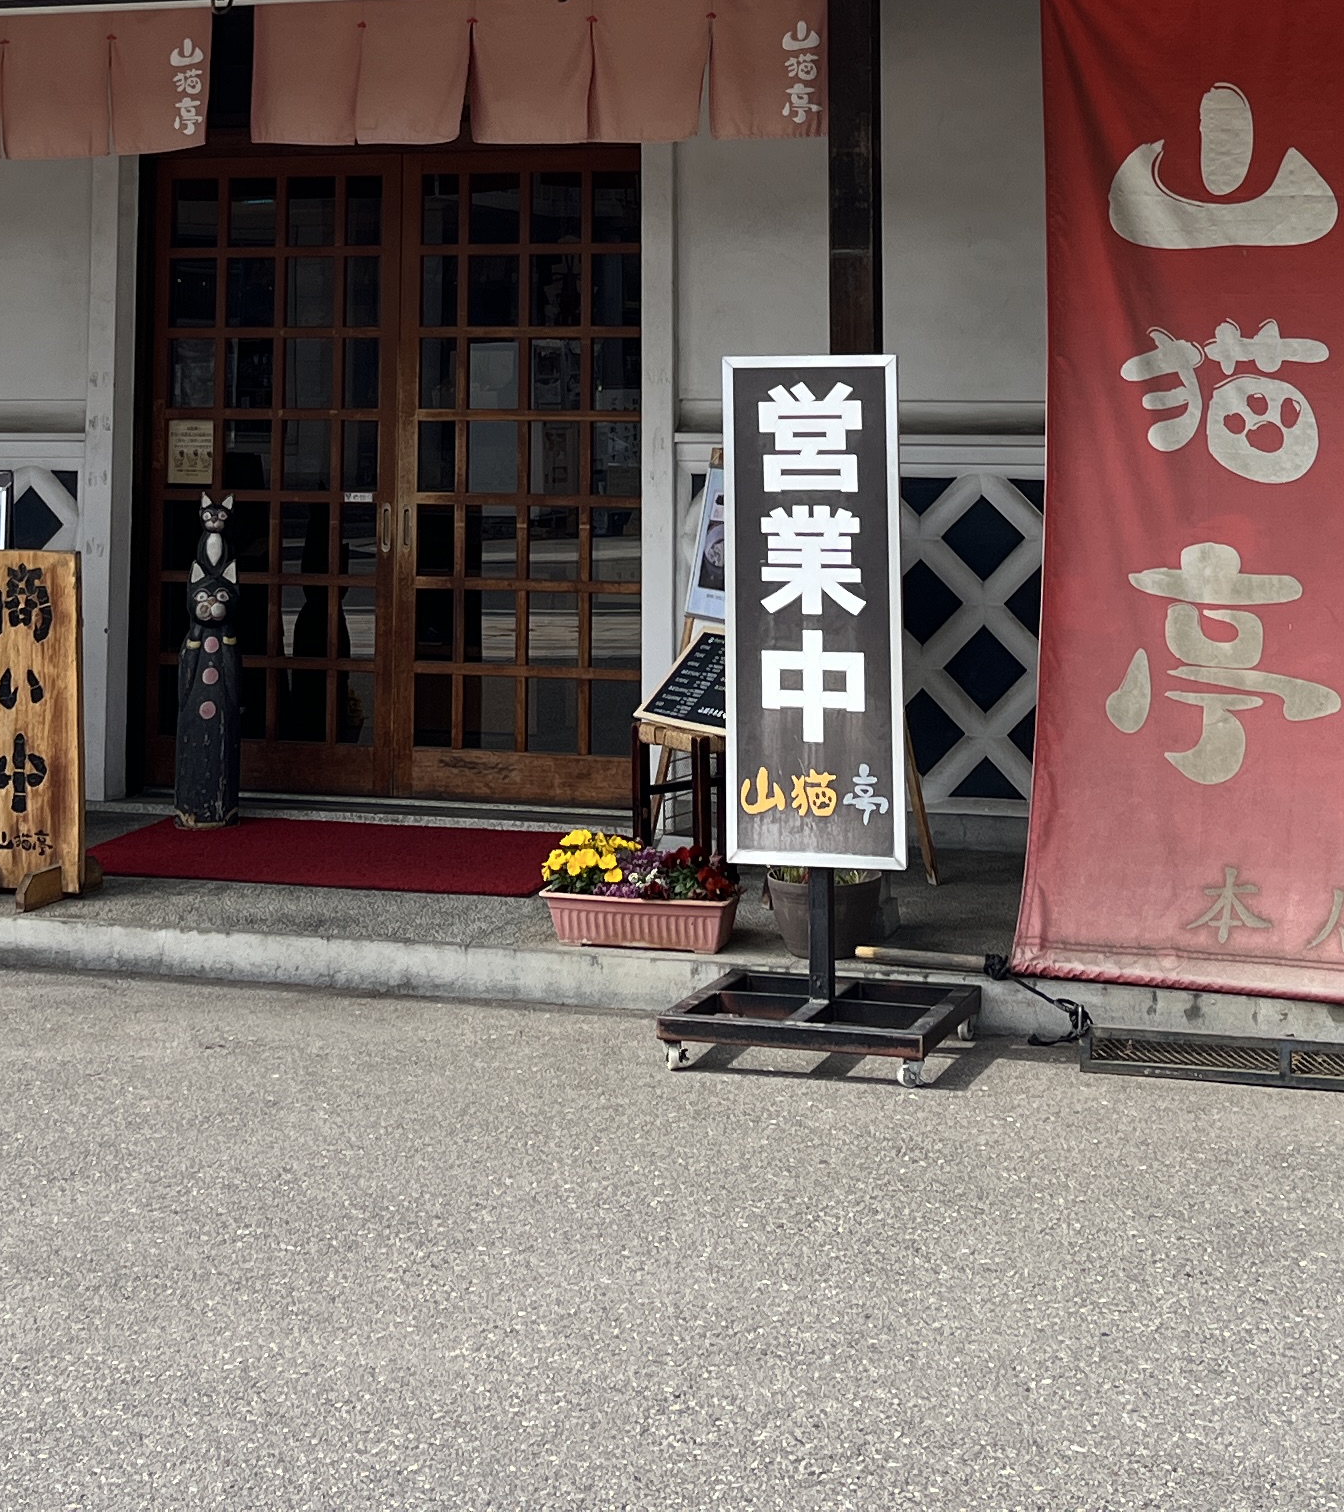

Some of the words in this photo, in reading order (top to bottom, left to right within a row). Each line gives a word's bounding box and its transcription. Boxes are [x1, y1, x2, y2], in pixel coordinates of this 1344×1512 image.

[170, 38, 204, 135] 山猫亭
[782, 20, 823, 124] 山猫亭
[1106, 82, 1342, 786] 山猫亭
[758, 381, 866, 742] 営業中
[741, 763, 889, 826] 山猫亭
